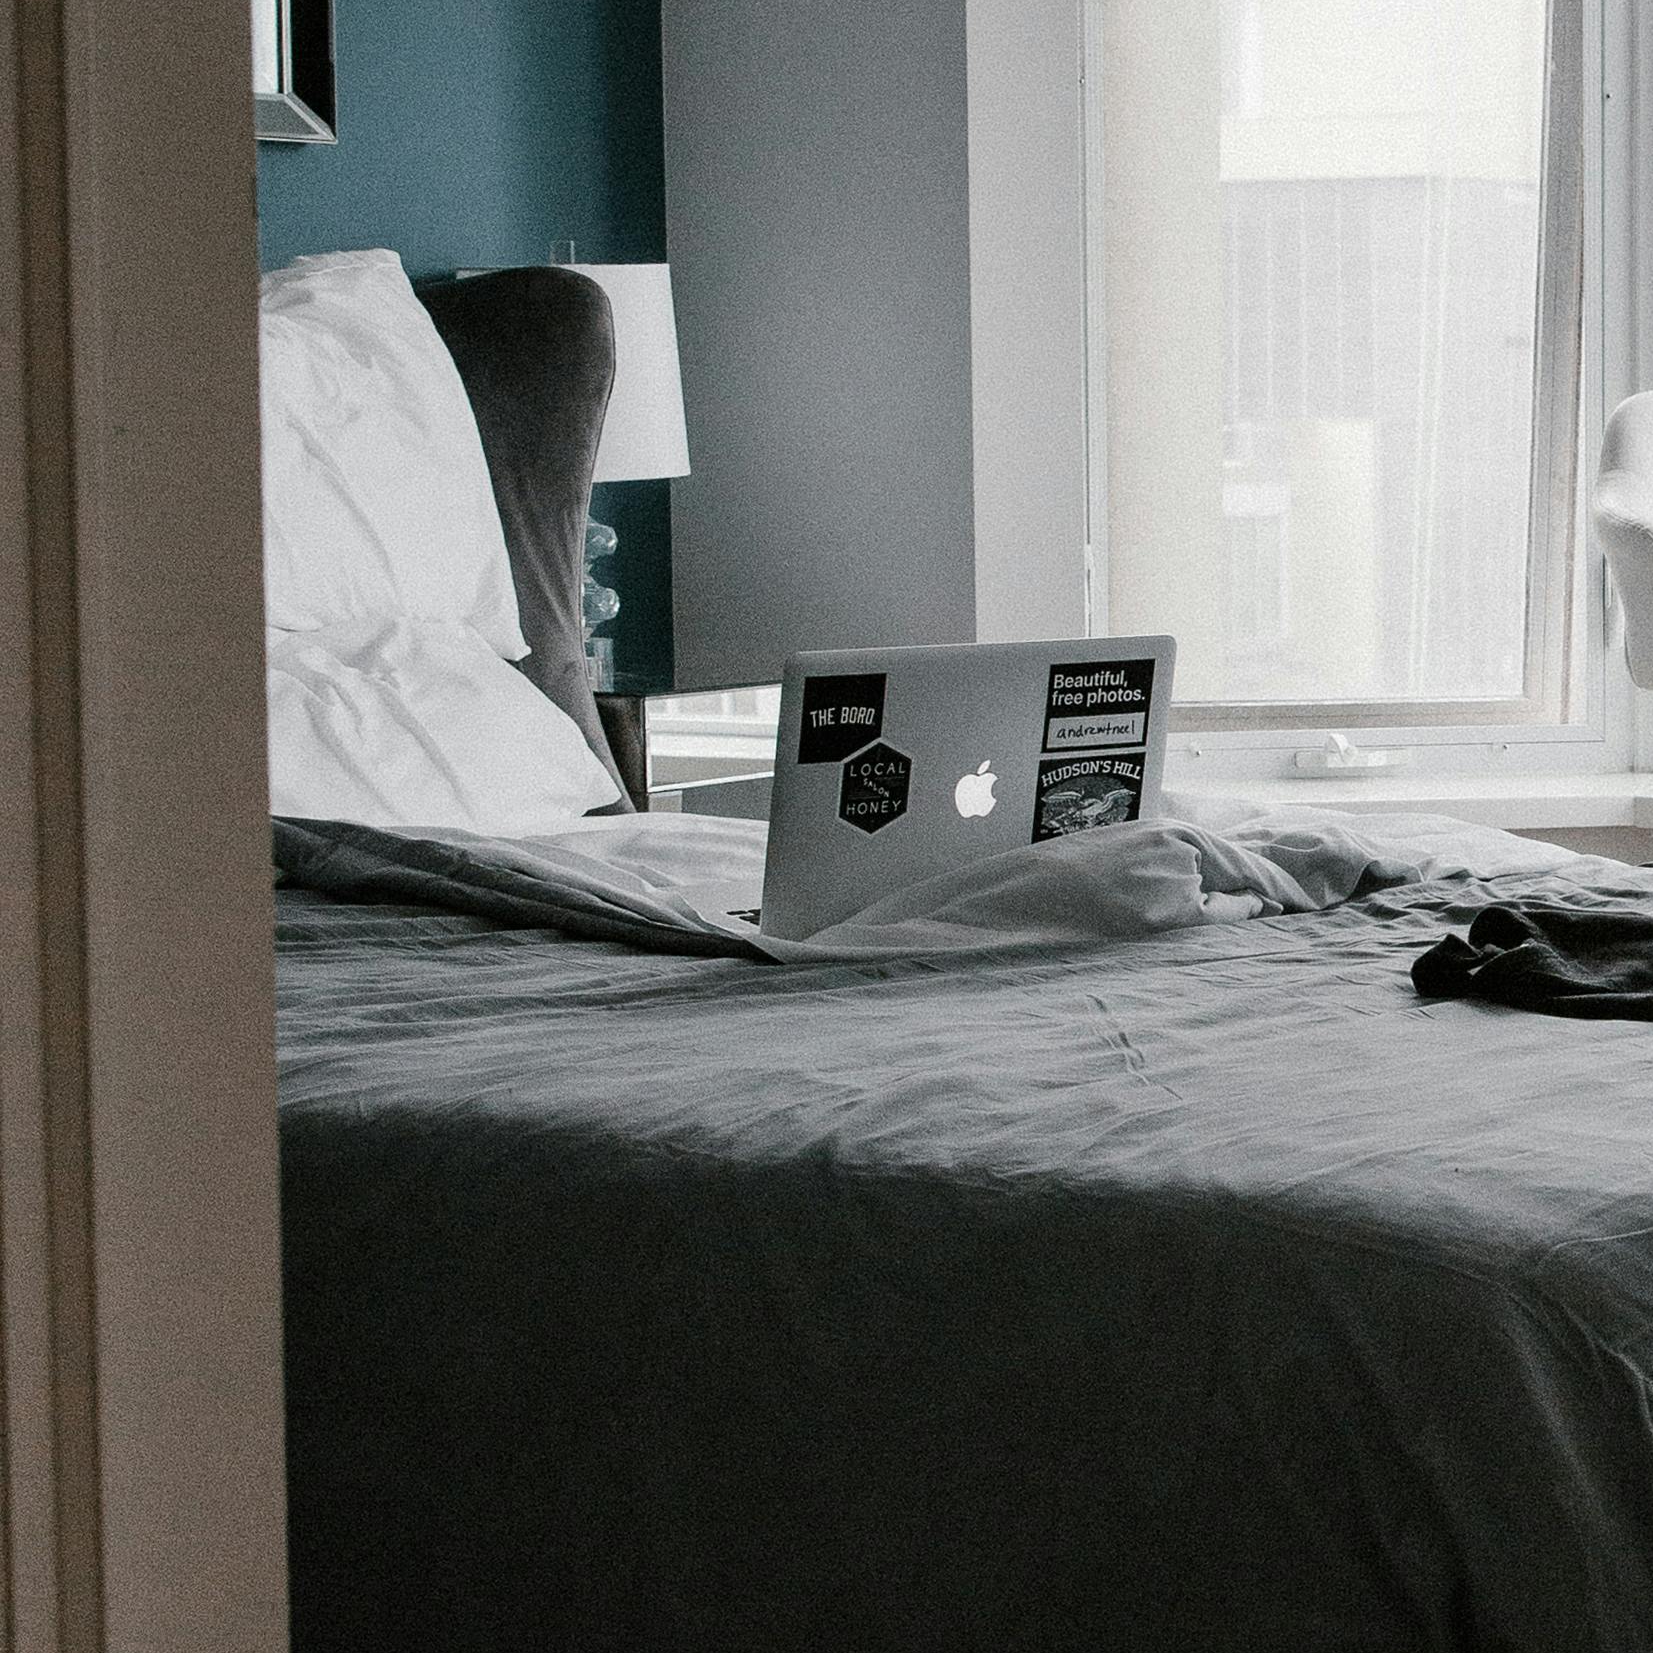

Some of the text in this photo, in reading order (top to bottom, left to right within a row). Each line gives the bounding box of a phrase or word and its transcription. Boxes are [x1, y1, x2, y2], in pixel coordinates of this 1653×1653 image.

[1053, 670, 1128, 689] Beautiful,
[1052, 688, 1146, 707] free photos.
[809, 707, 836, 728] THE
[850, 762, 906, 777] LOCAL
[1041, 760, 1141, 787] HUDSON'S HILL
[863, 777, 890, 798] SALON
[846, 799, 902, 815] HONEY
